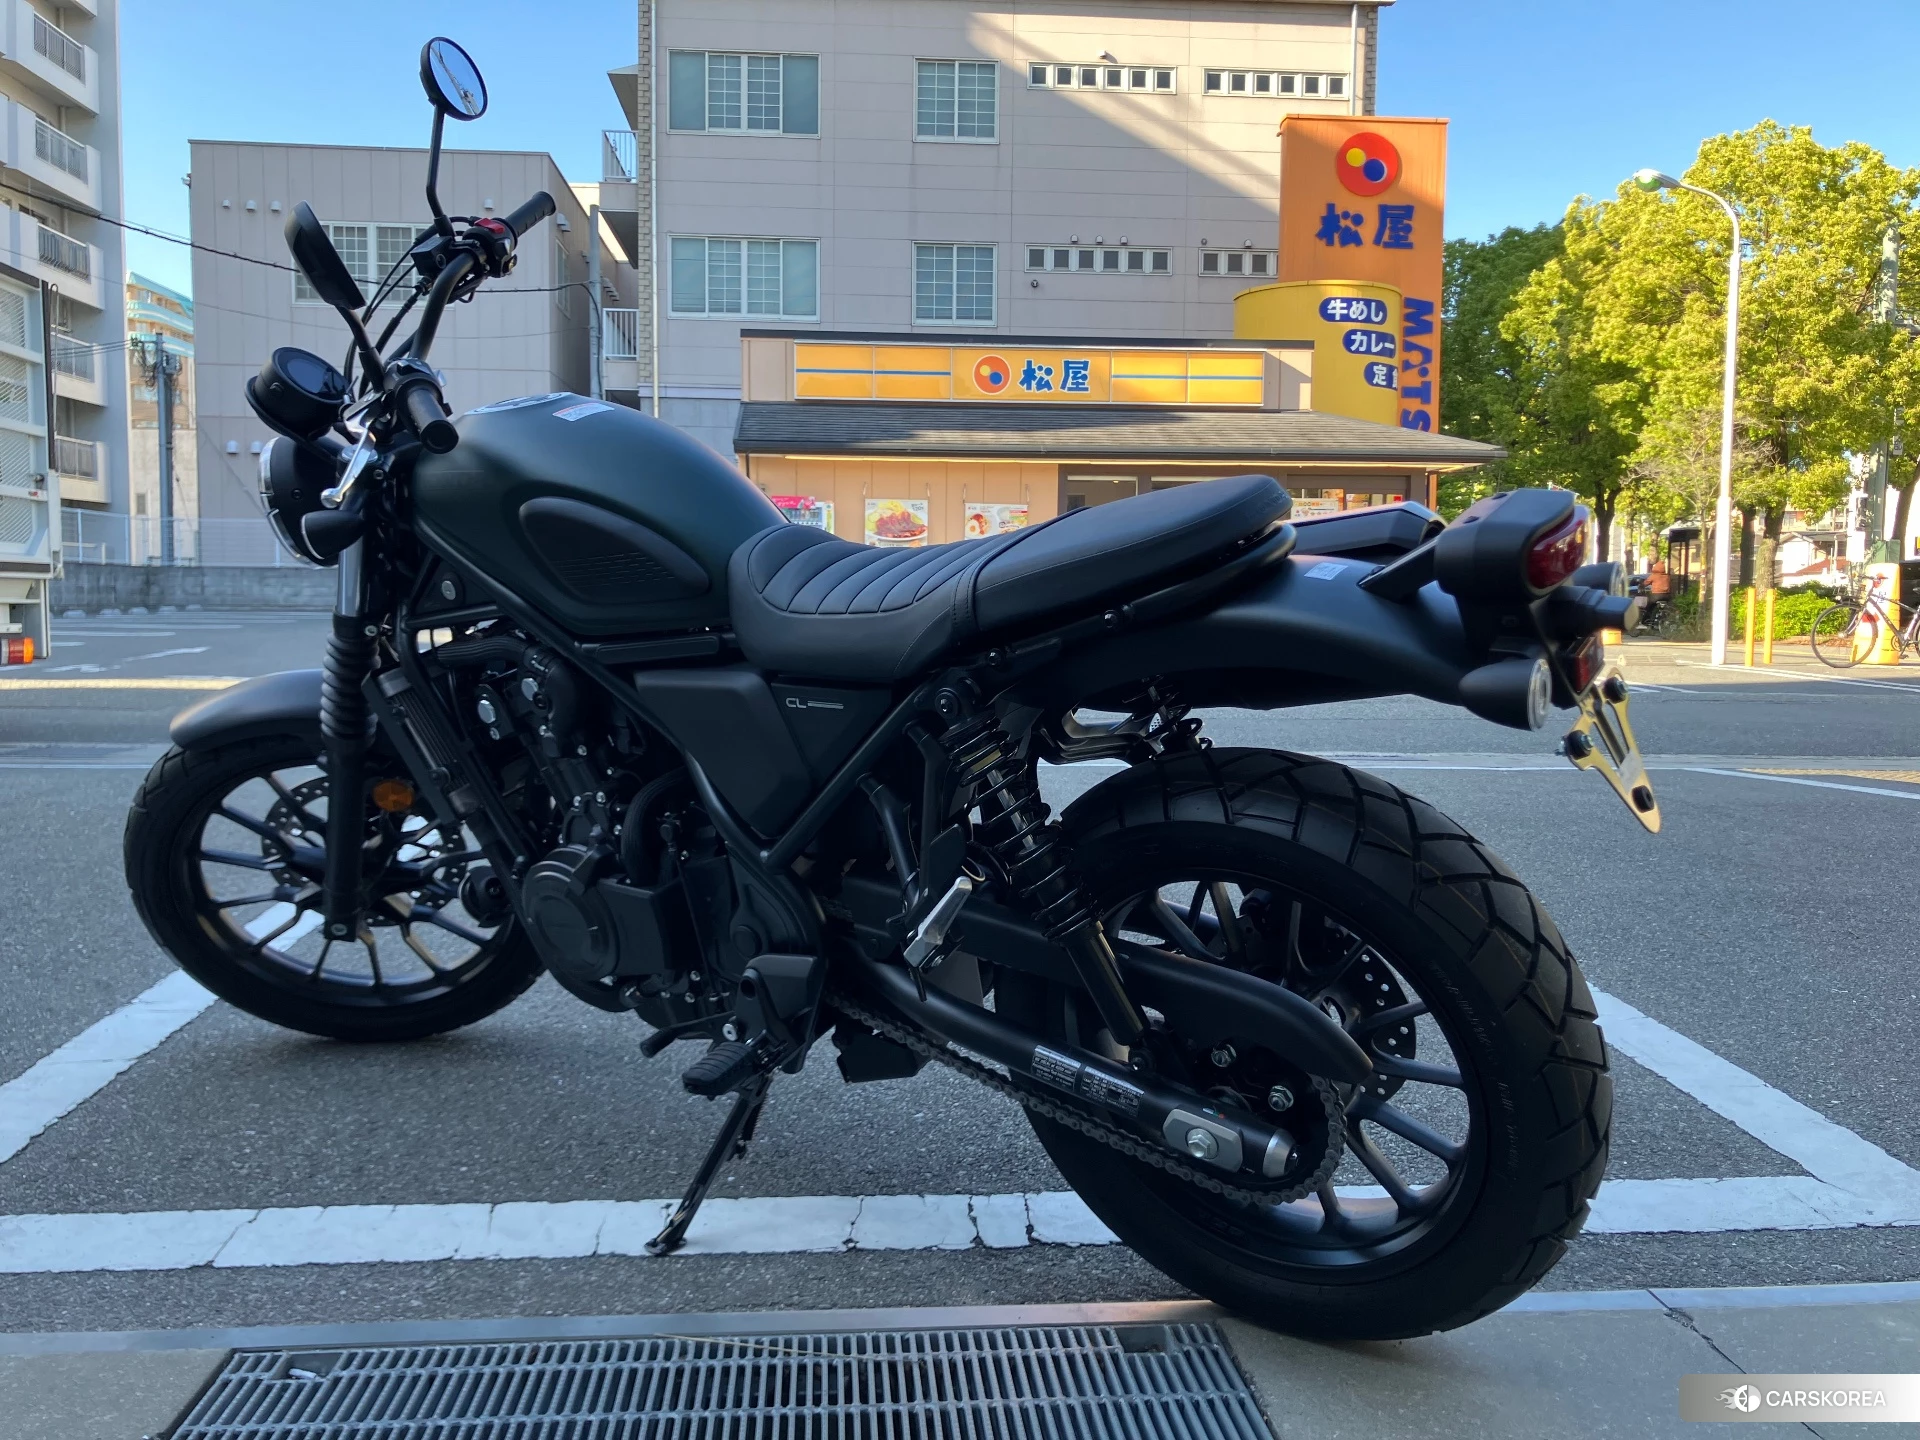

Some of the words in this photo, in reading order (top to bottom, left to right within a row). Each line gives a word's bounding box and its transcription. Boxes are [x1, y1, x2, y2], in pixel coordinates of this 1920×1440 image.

[1315, 203, 1414, 249] 松屋
[1327, 299, 1383, 323] 牛めし
[1350, 331, 1395, 353] カレー
[1018, 359, 1090, 393] 松屋
[785, 697, 807, 709] CL
